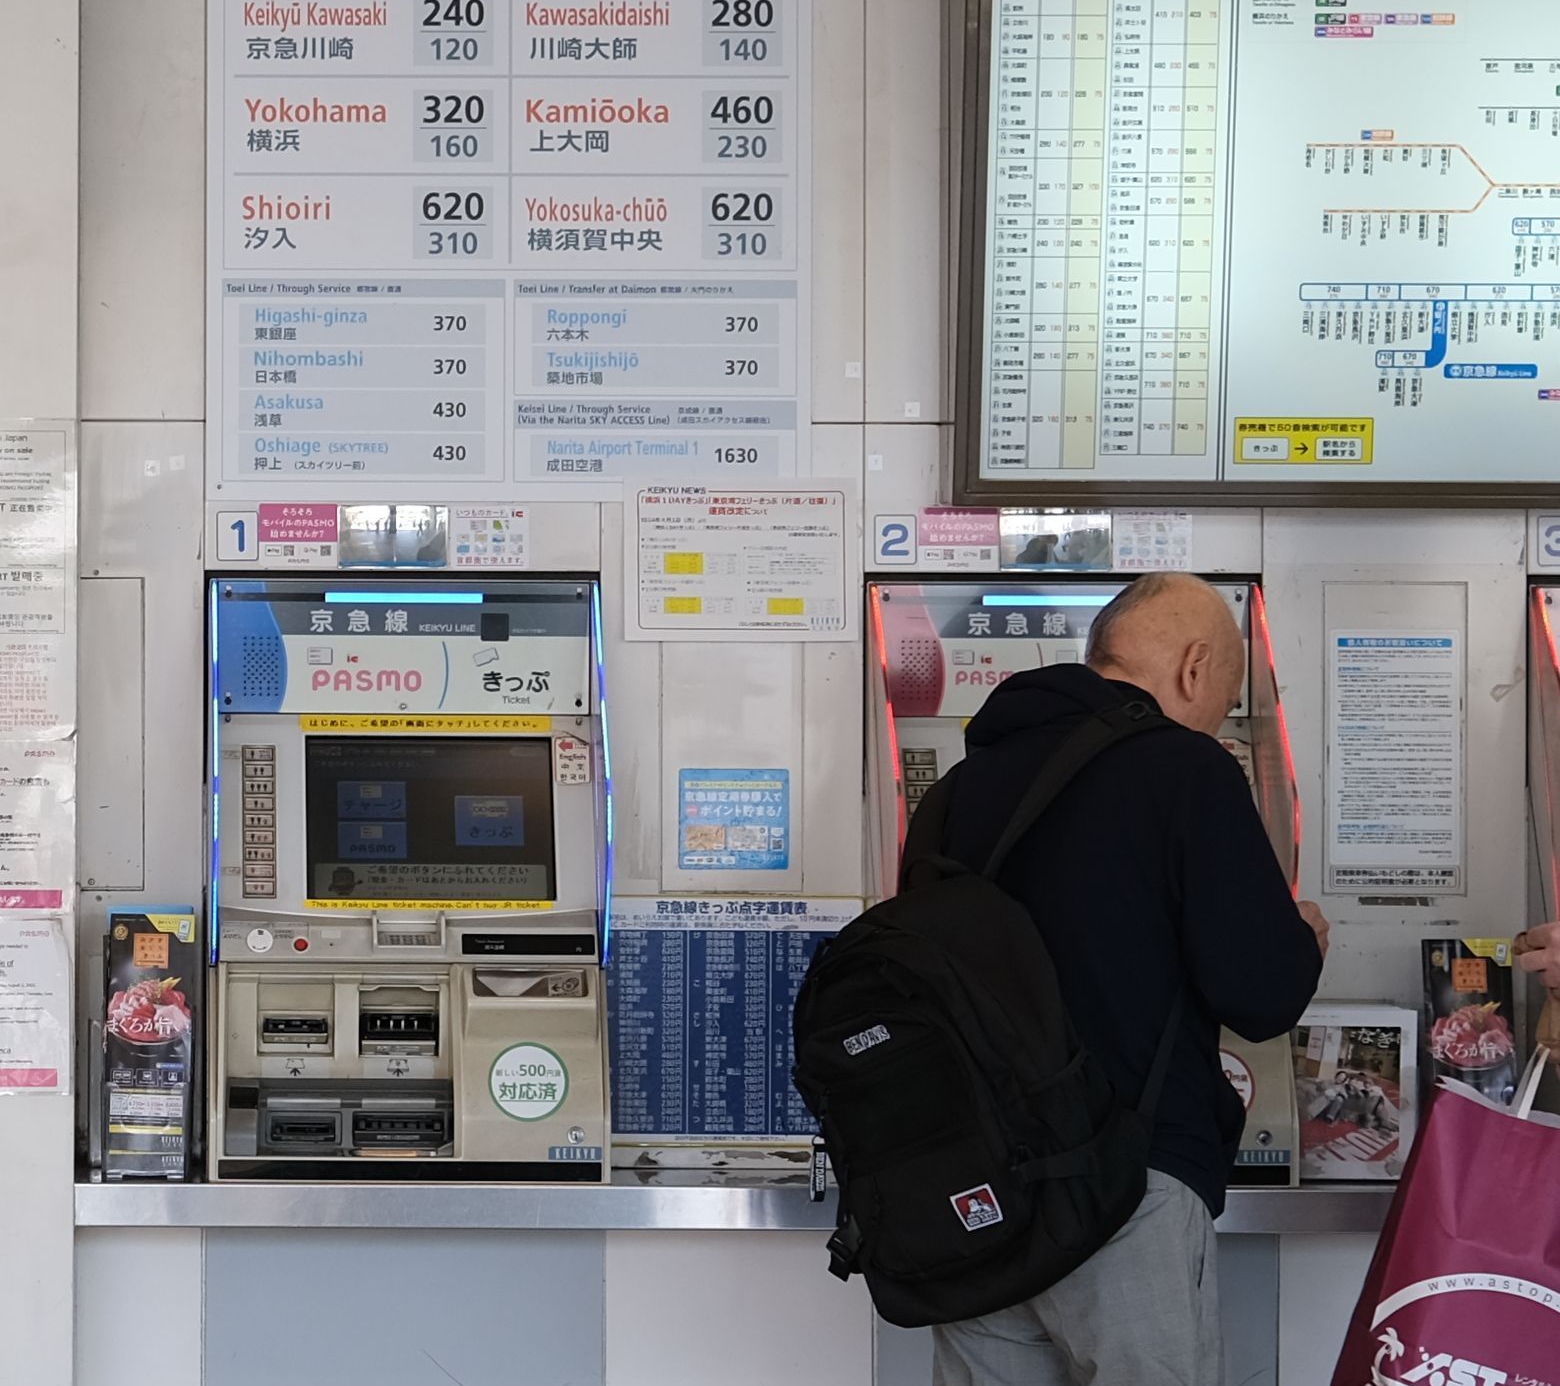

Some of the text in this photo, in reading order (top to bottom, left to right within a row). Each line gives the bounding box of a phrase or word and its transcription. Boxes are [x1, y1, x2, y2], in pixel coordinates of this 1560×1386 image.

[244, 1, 387, 29] Keikyū Kawasaki
[421, 0, 484, 26] 240
[526, 2, 670, 27] Kawasakidaishi
[711, 0, 773, 27] 280
[246, 37, 354, 61] 京急川崎
[430, 39, 478, 61] 120
[530, 38, 637, 61] 川崎大師
[718, 39, 767, 62] 140
[246, 100, 387, 123] Yokohama
[422, 96, 484, 124] 320
[525, 99, 669, 124] Kamiōoka
[710, 96, 773, 124] 460
[247, 130, 301, 153] 横浜
[430, 136, 478, 158] 160
[530, 130, 610, 154] 上大岡
[717, 136, 767, 159] 230
[242, 196, 331, 221] Shioiri
[421, 193, 484, 220] 620
[525, 197, 667, 222] Yokosuka-chūō
[710, 194, 773, 221] 620
[244, 227, 297, 249] 汐入
[428, 232, 477, 255] 310
[527, 229, 662, 252] 横須賀中央
[717, 233, 767, 256] 310
[255, 309, 367, 326] Higashi-ginza
[433, 316, 466, 331] 370
[548, 309, 627, 327] Roppongi
[725, 317, 758, 332] 370
[254, 327, 296, 340] 東銀座
[547, 328, 589, 341] 六本木
[254, 351, 364, 367] Nihombashi
[433, 359, 466, 375] 370
[547, 352, 638, 370] Tsukijishijō
[725, 361, 758, 375] 370
[254, 371, 296, 383] 日本橋
[547, 372, 603, 385] 築地市場
[254, 394, 324, 409] Asakusa
[433, 403, 466, 417] 430
[254, 414, 282, 427] 浅草
[610, 416, 644, 425] ACCESS
[254, 437, 320, 456] Oshiage
[433, 446, 466, 461] 430
[548, 441, 698, 458] Narita Airport Terminal 1
[715, 449, 758, 463] 1630
[254, 457, 282, 470] 押上
[547, 459, 603, 472] 成田空港
[262, 518, 335, 528] モバイルのPASMO
[231, 520, 245, 551] 1
[881, 524, 910, 557] 2
[310, 610, 475, 633] 京急線 KEIKYU LINE
[968, 613, 1067, 636] 京急線
[312, 670, 550, 692] PASMO きっぷ
[844, 1037, 863, 1054] BEN
[499, 1083, 557, 1100] 対応済
[555, 1149, 596, 1159] KEIKYU
